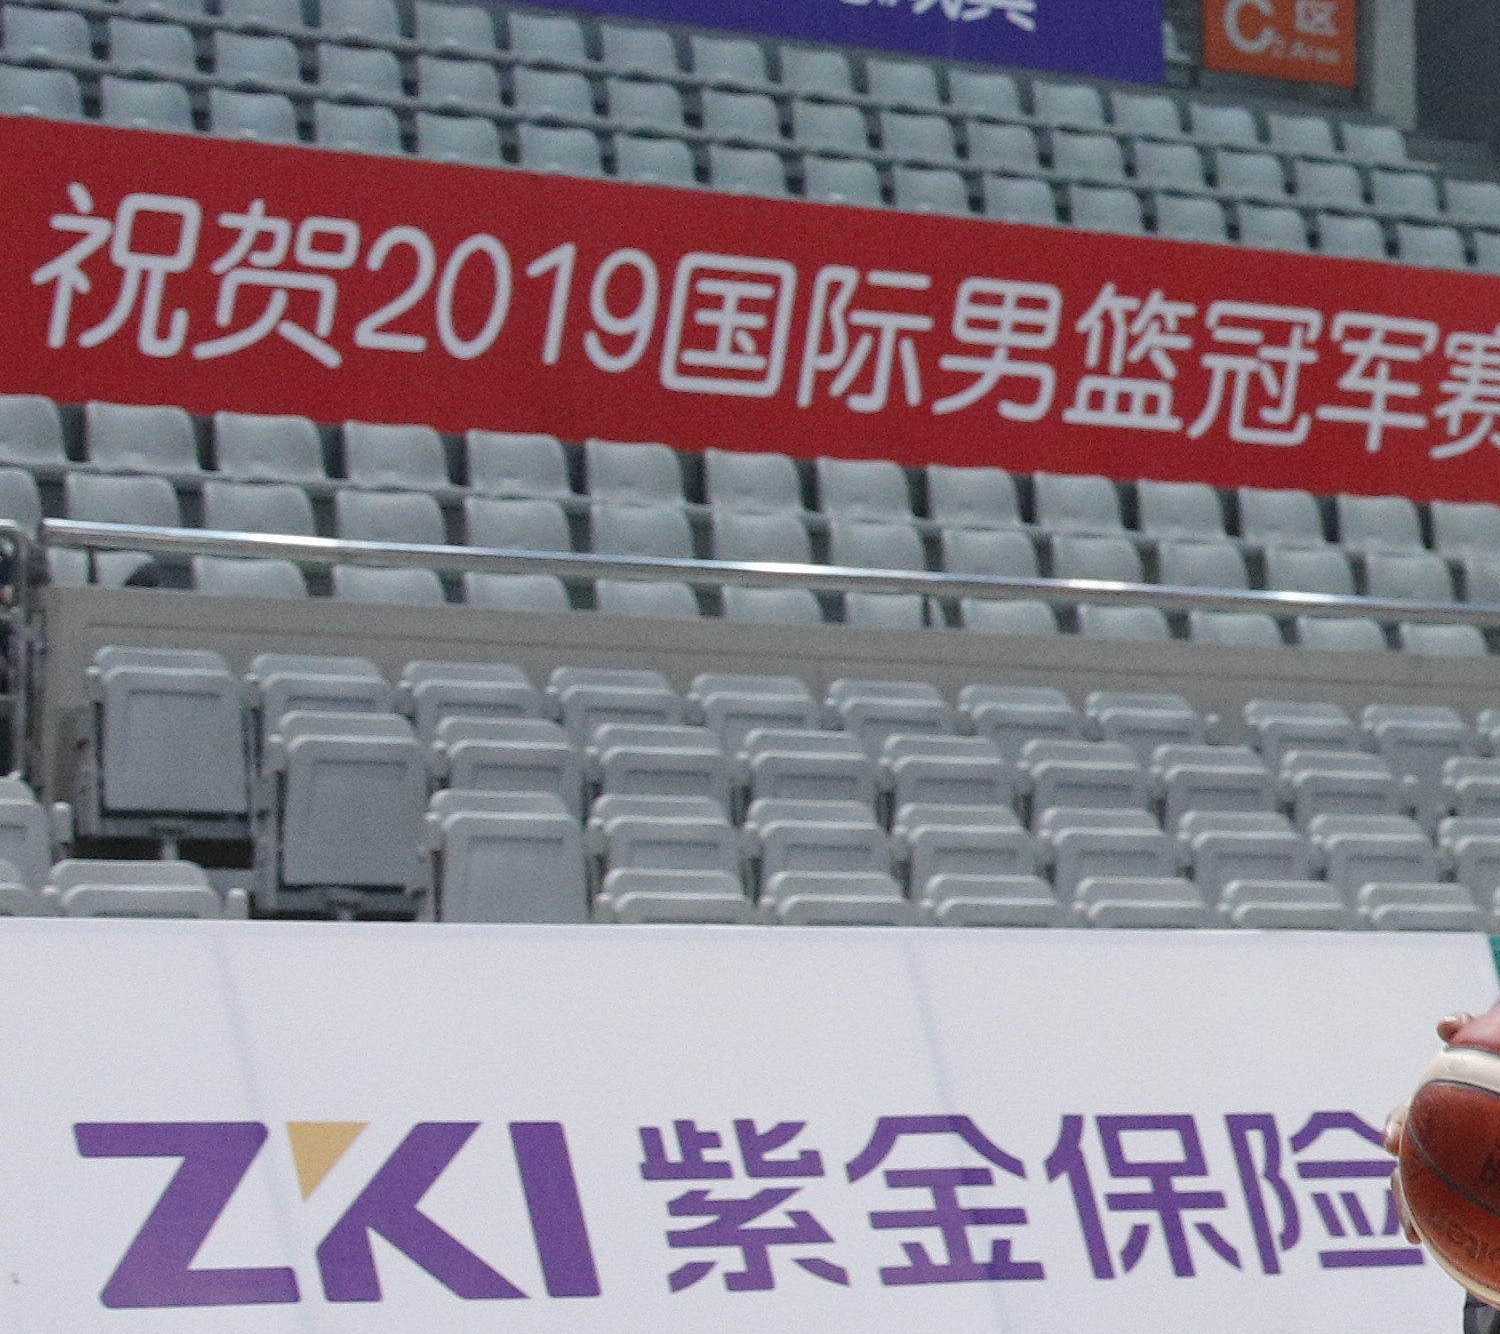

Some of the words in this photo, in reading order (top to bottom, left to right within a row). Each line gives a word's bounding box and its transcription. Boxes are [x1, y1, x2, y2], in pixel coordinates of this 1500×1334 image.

[73, 1119, 601, 1310] ZKI
[637, 1110, 1424, 1294] 紫金保险
